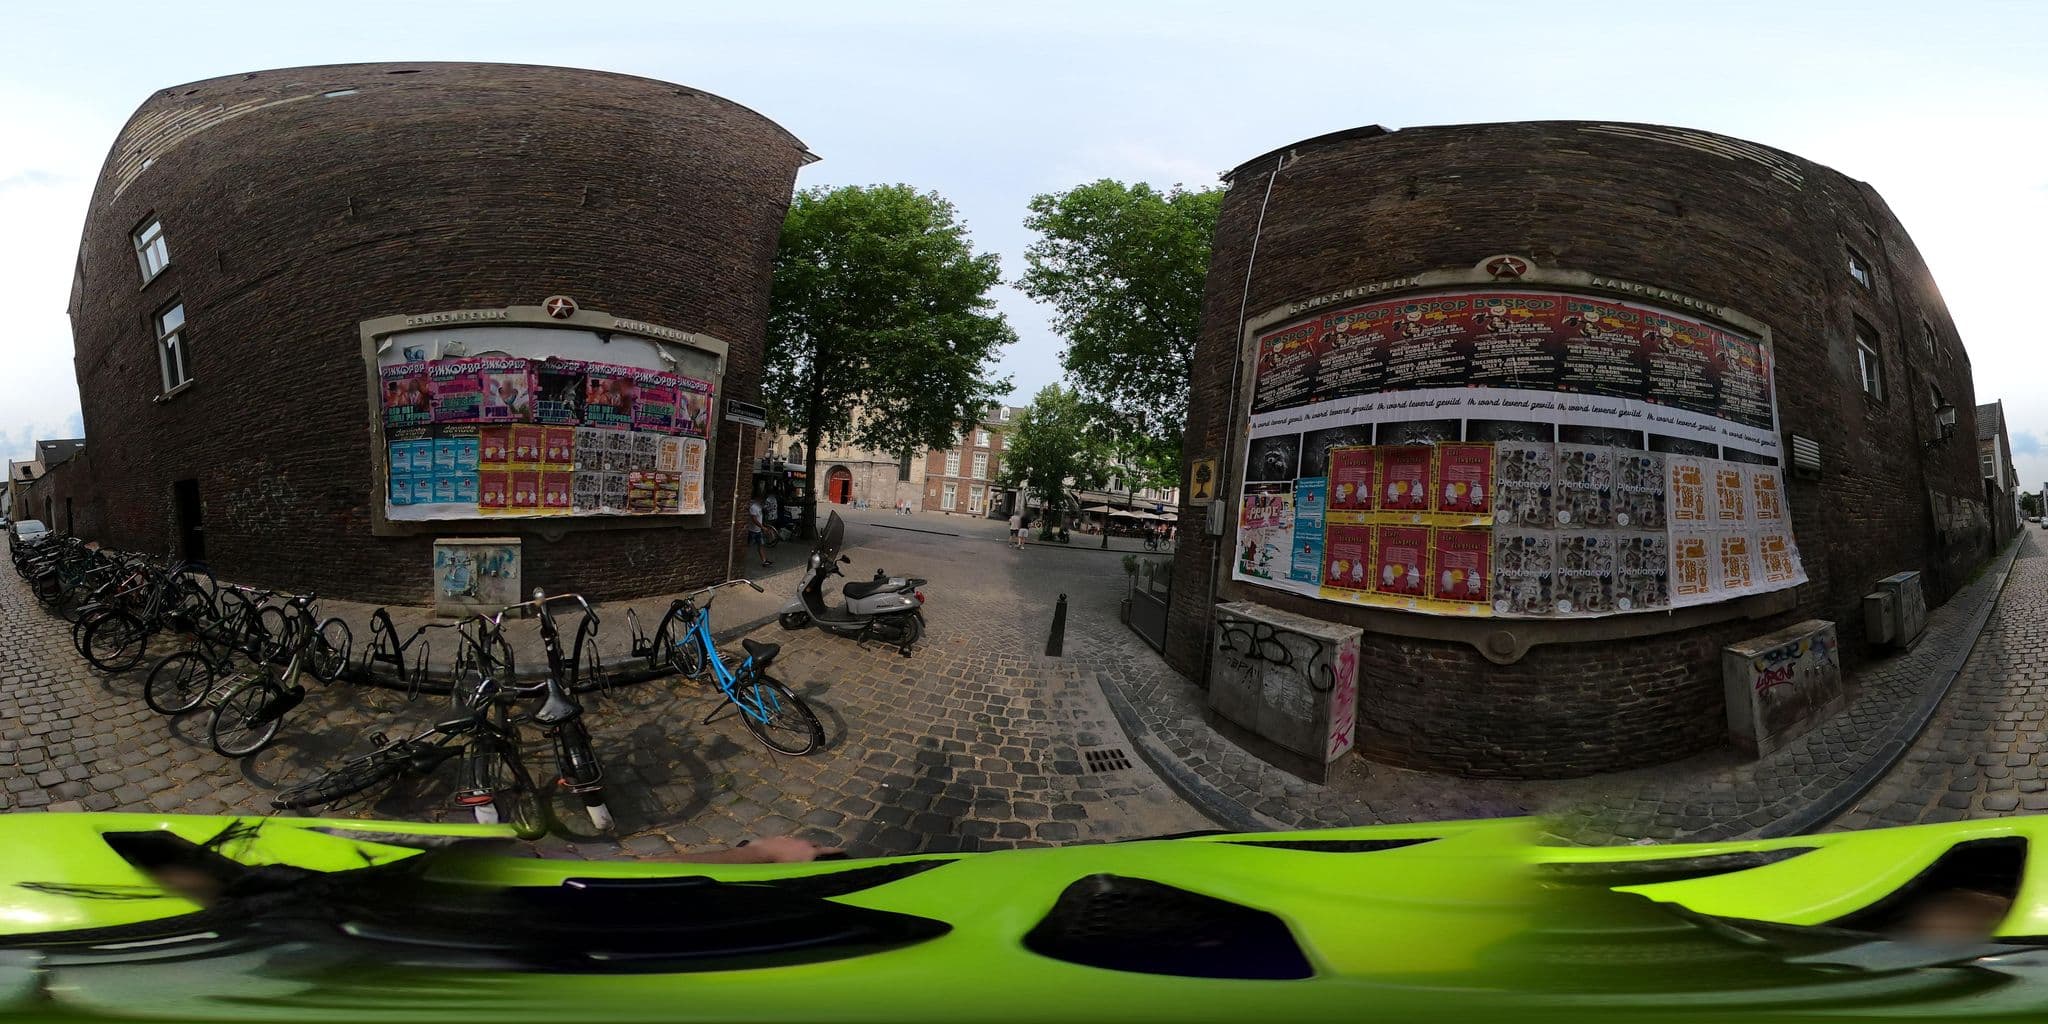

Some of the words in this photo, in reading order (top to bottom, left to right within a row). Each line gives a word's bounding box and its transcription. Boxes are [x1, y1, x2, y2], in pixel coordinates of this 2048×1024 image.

[1290, 277, 1420, 315] GEMEENTELIJK
[1592, 278, 1724, 317] AANPLAKBORD
[1393, 301, 1469, 317] BOSPOP
[1472, 298, 1554, 309] BOSPOP
[1324, 308, 1391, 329] BOSPOP
[1264, 326, 1316, 350] BOSPOP
[1387, 401, 1407, 410] word
[1408, 399, 1435, 408] levend
[1502, 399, 1529, 408] levend
[1568, 404, 1589, 412] word
[1592, 405, 1617, 415] levend
[1558, 480, 1611, 492] Plantiarchy
[1557, 569, 1612, 580] Plantiarchy
[1618, 568, 1666, 579] Plantiarchy
